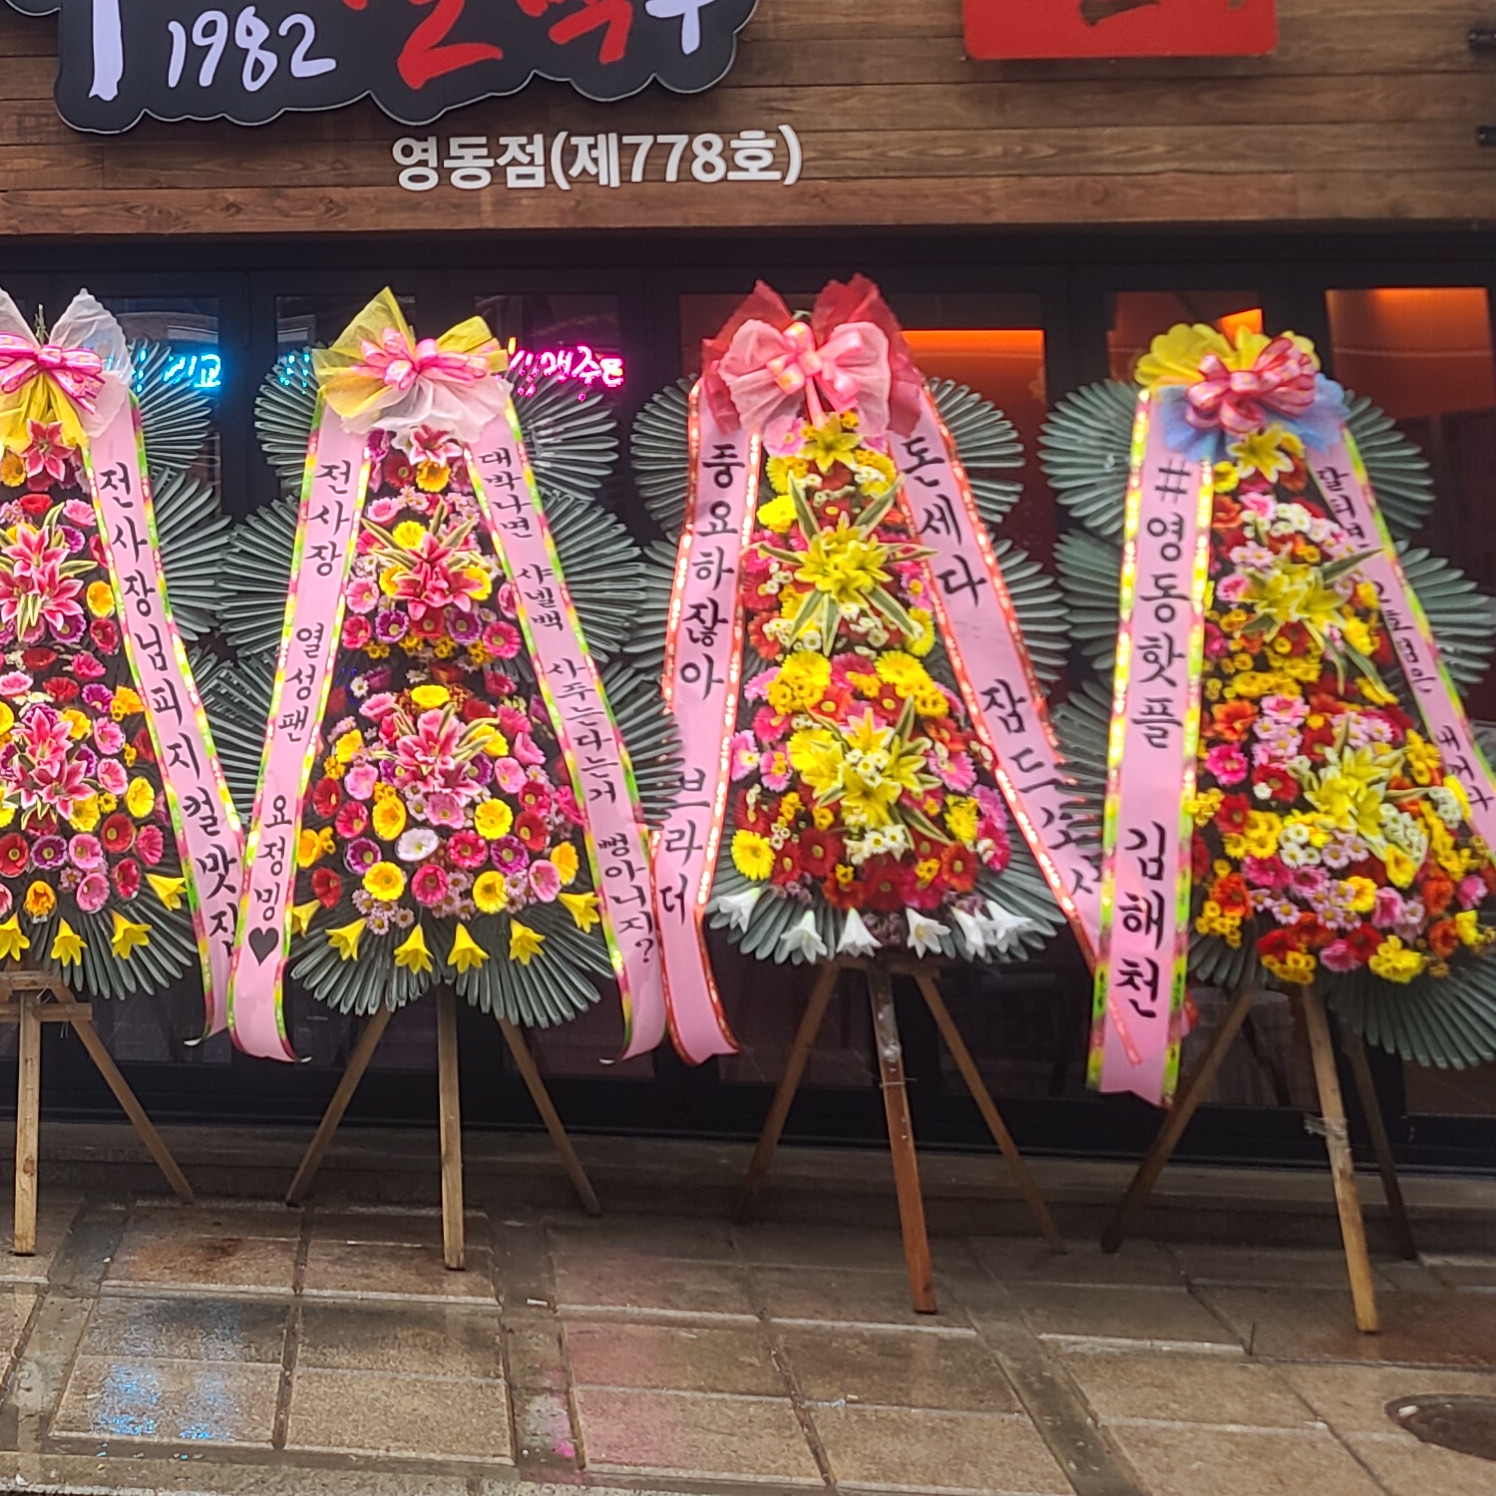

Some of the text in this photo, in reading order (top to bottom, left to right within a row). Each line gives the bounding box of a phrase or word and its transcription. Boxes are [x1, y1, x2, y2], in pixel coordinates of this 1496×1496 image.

[167, 9, 337, 92] 1982
[391, 124, 803, 192] 영동점(제778호)
[303, 459, 351, 577] 전사장
[477, 446, 533, 540] 대박나면
[516, 562, 565, 632] 샤넬백
[900, 435, 988, 609] 돈세다
[277, 621, 325, 743] 열성팬
[659, 443, 746, 926] 중요하잖아 브라더
[1114, 456, 1192, 1020] #영동핫플 김해천
